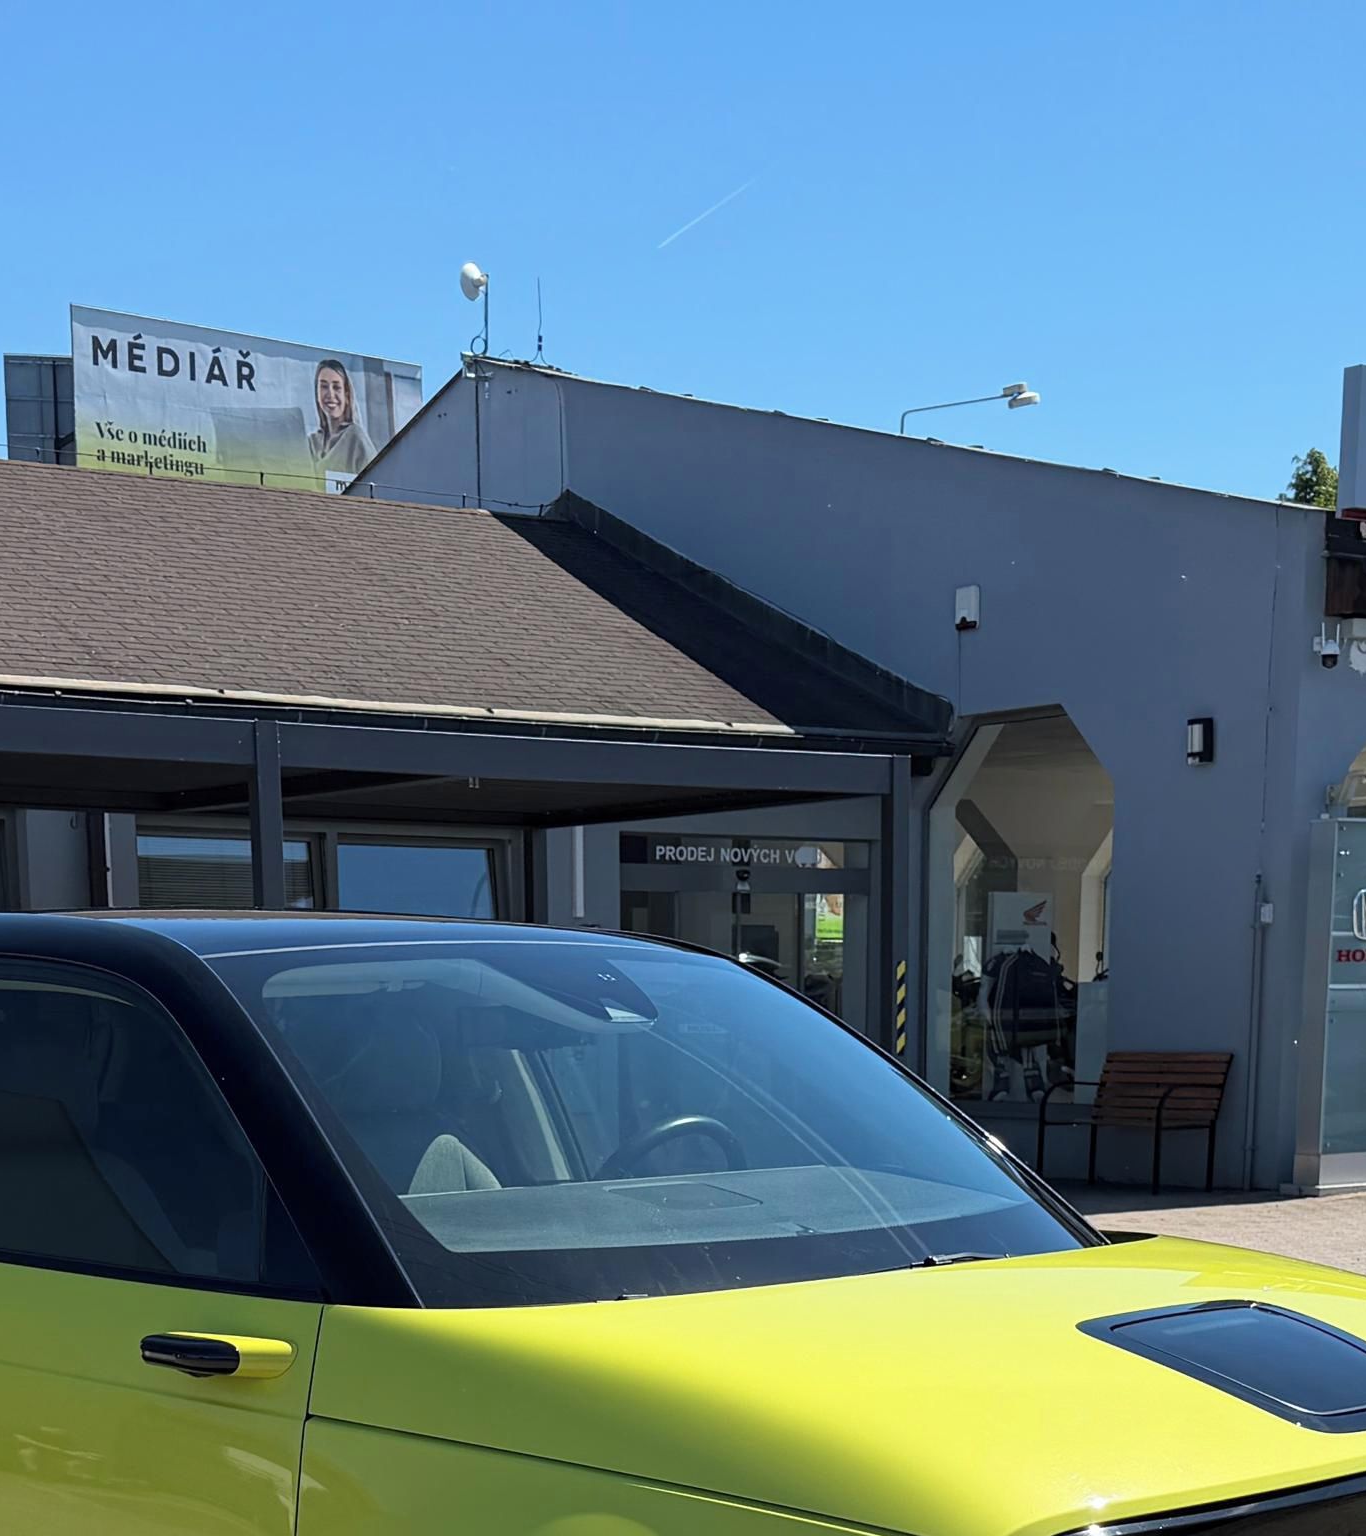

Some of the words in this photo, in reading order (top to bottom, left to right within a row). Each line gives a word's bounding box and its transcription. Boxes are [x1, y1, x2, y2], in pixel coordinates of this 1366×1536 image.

[91, 332, 257, 392] MÉDIÁŘ
[94, 420, 124, 442] Vše
[128, 430, 138, 444] o
[142, 429, 208, 454] médiích
[96, 448, 107, 462] a
[110, 448, 205, 477] marketingu
[655, 845, 715, 863] PRODEJ
[720, 844, 780, 864] NOVÝCH
